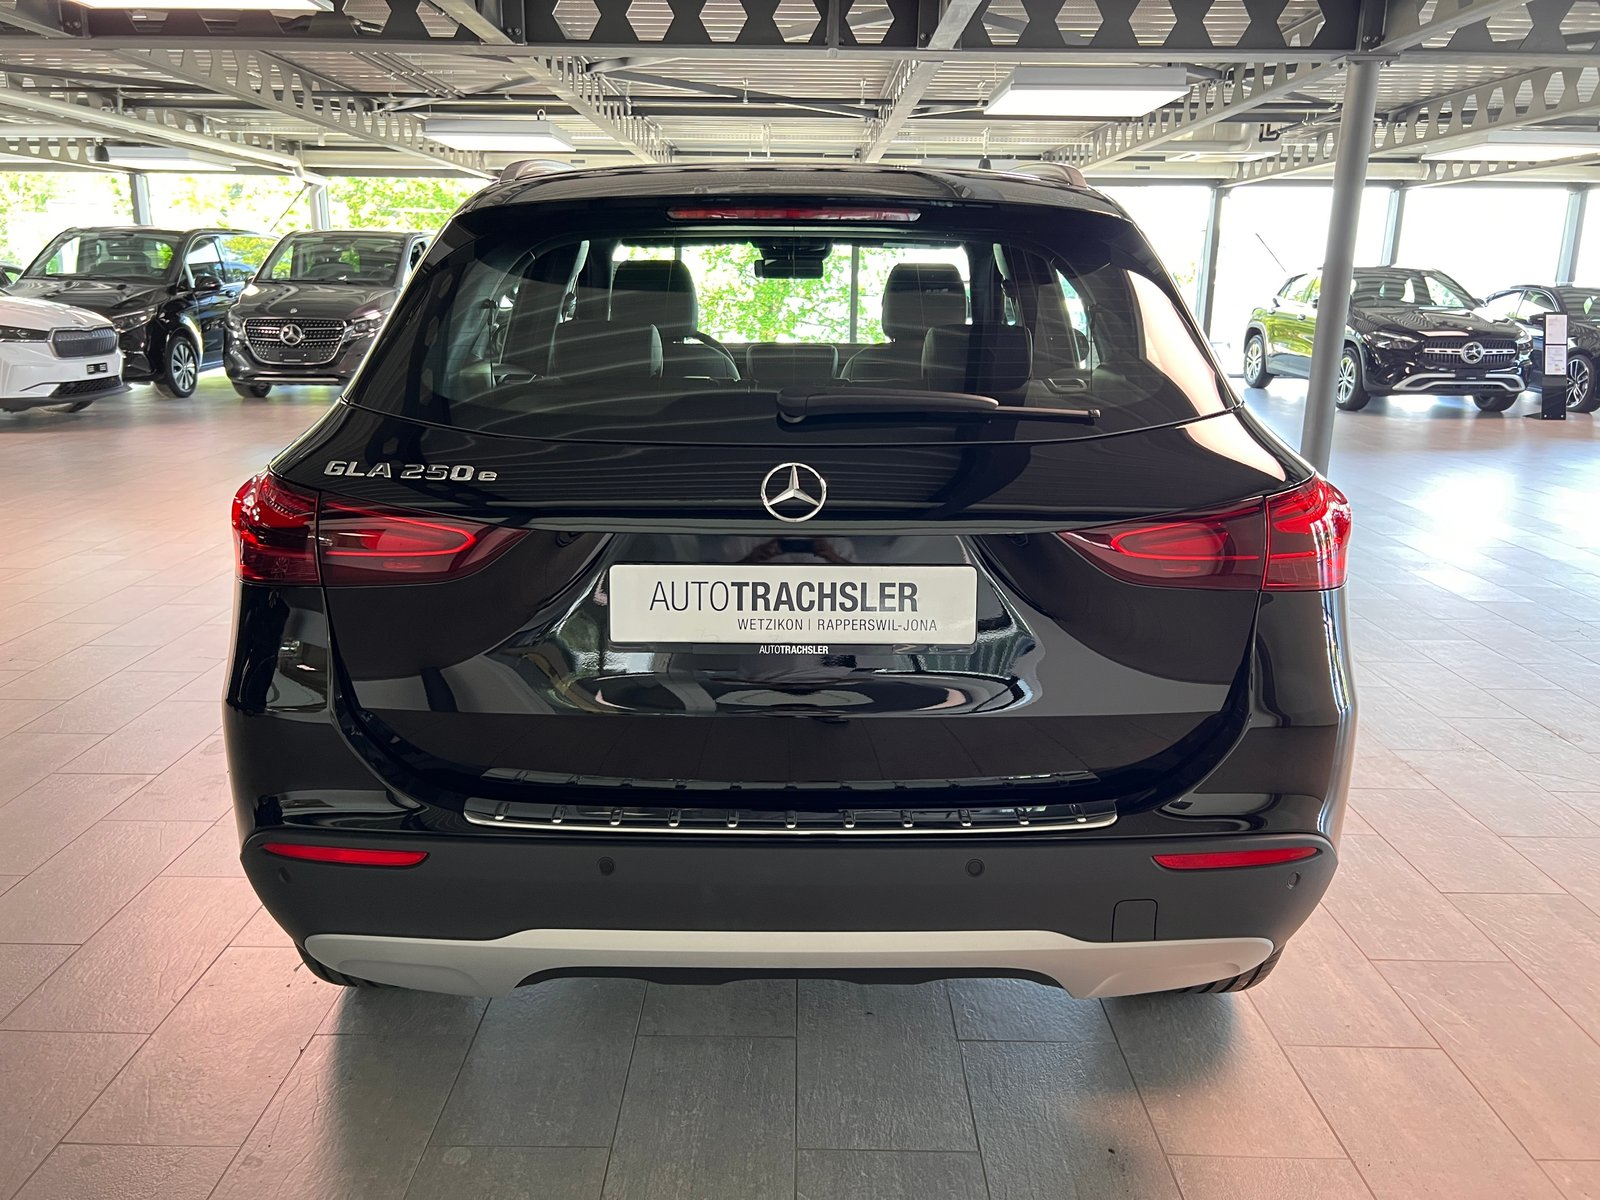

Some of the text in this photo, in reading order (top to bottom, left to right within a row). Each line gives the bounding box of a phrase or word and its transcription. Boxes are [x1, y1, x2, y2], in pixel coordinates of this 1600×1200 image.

[323, 460, 392, 479] GLA
[649, 580, 919, 613] AUTOTRACHSLER
[737, 618, 803, 632] WETZIKON
[817, 618, 938, 632] RAPPERSWIL-JONA
[759, 644, 829, 655] AUTOTRACHSLER
